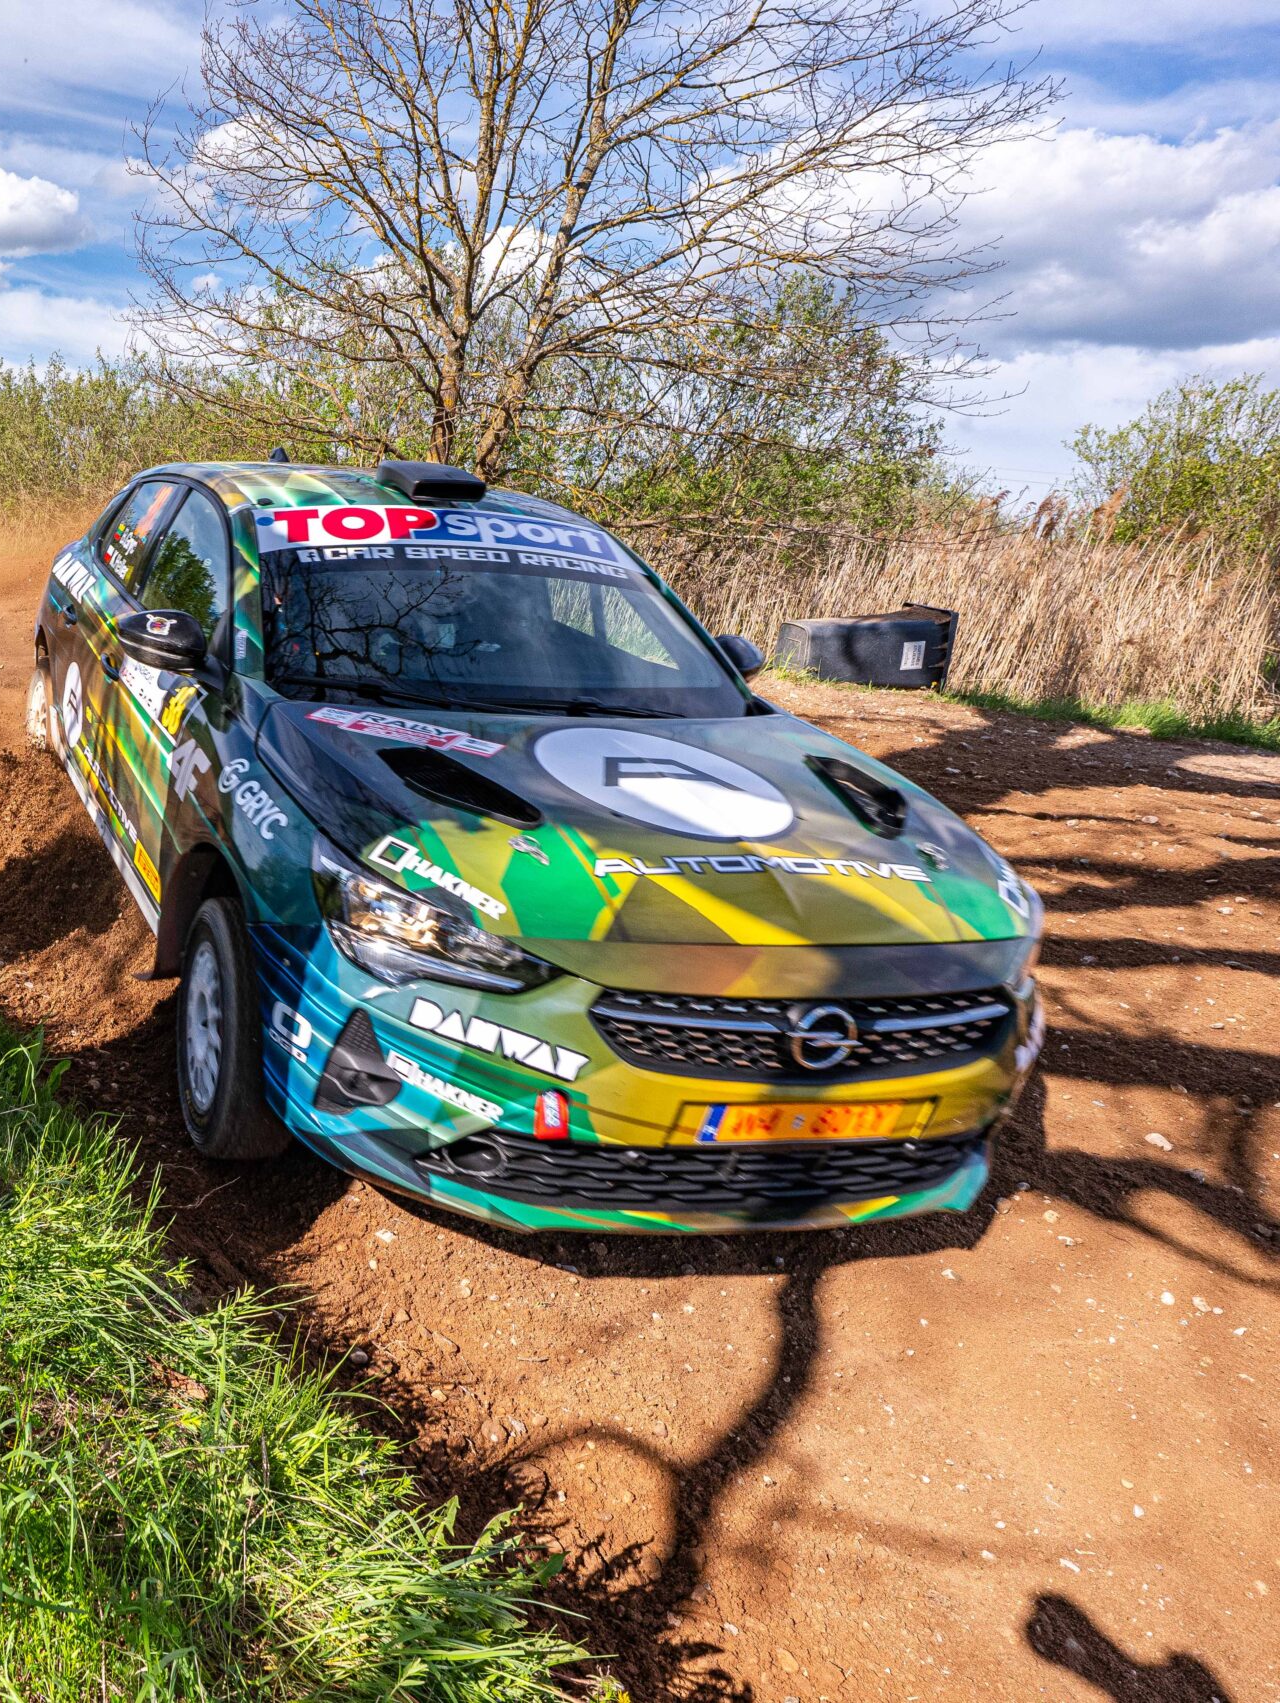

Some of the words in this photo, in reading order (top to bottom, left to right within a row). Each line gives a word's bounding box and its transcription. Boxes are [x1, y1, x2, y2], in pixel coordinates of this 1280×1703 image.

[404, 546, 511, 564] SPEED
[519, 552, 629, 579] RACING
[360, 714, 455, 736] RALLY
[235, 780, 289, 840] GRYC
[594, 855, 933, 883] AUTOMOTIVE
[403, 853, 508, 921] HAKNER
